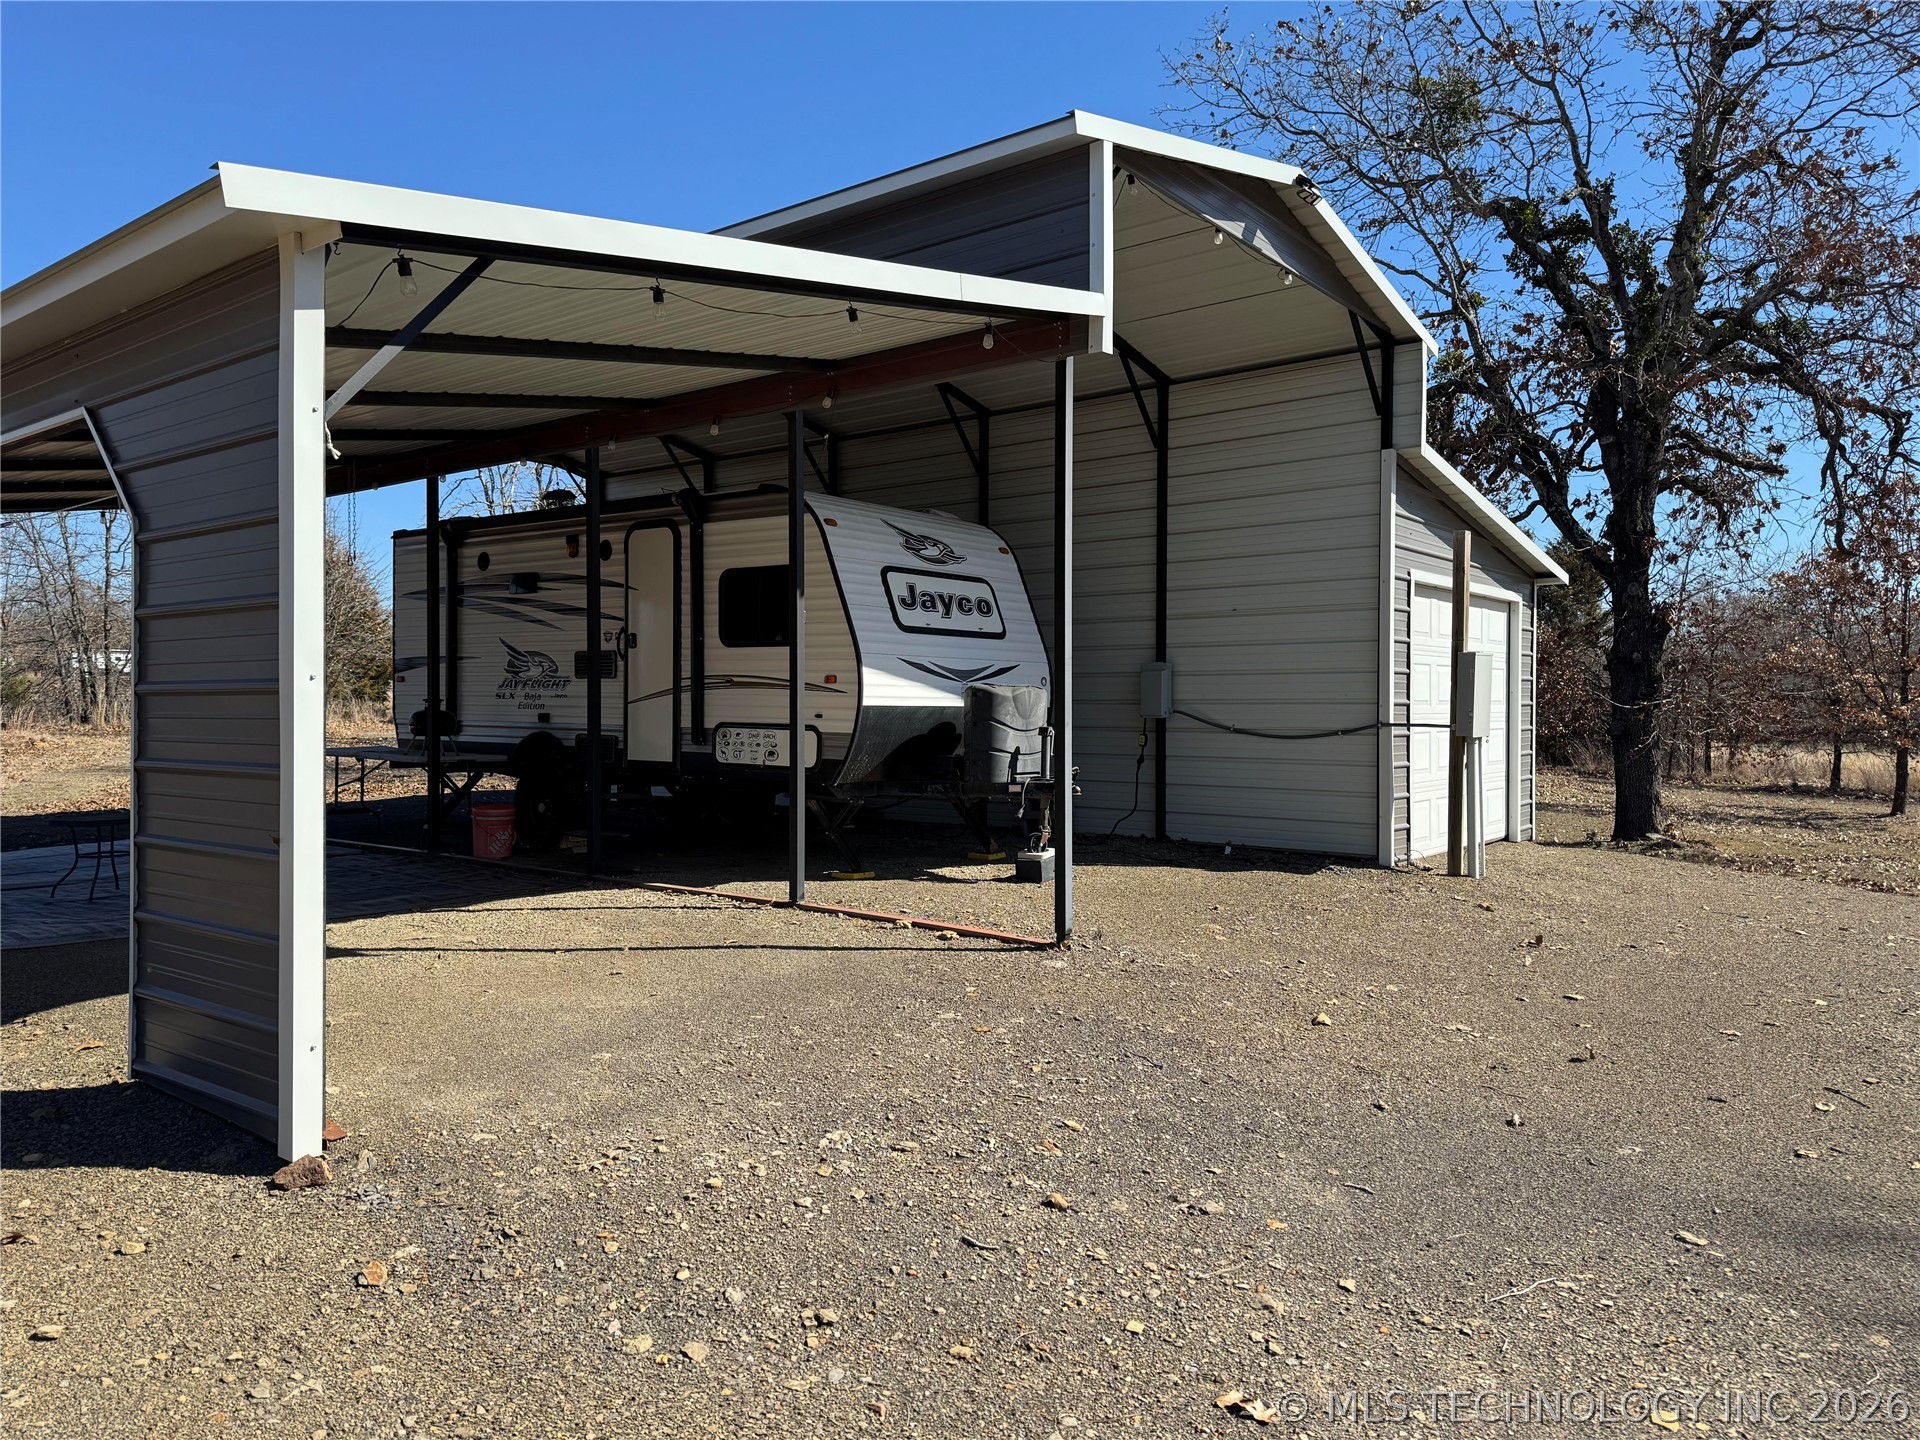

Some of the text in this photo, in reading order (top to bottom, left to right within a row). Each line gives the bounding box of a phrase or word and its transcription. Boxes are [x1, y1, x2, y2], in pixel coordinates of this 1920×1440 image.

[897, 582, 994, 619] Jayco
[495, 692, 516, 700] SLX
[523, 692, 542, 702] Baja
[517, 702, 545, 710] Edition
[733, 750, 743, 759] GT
